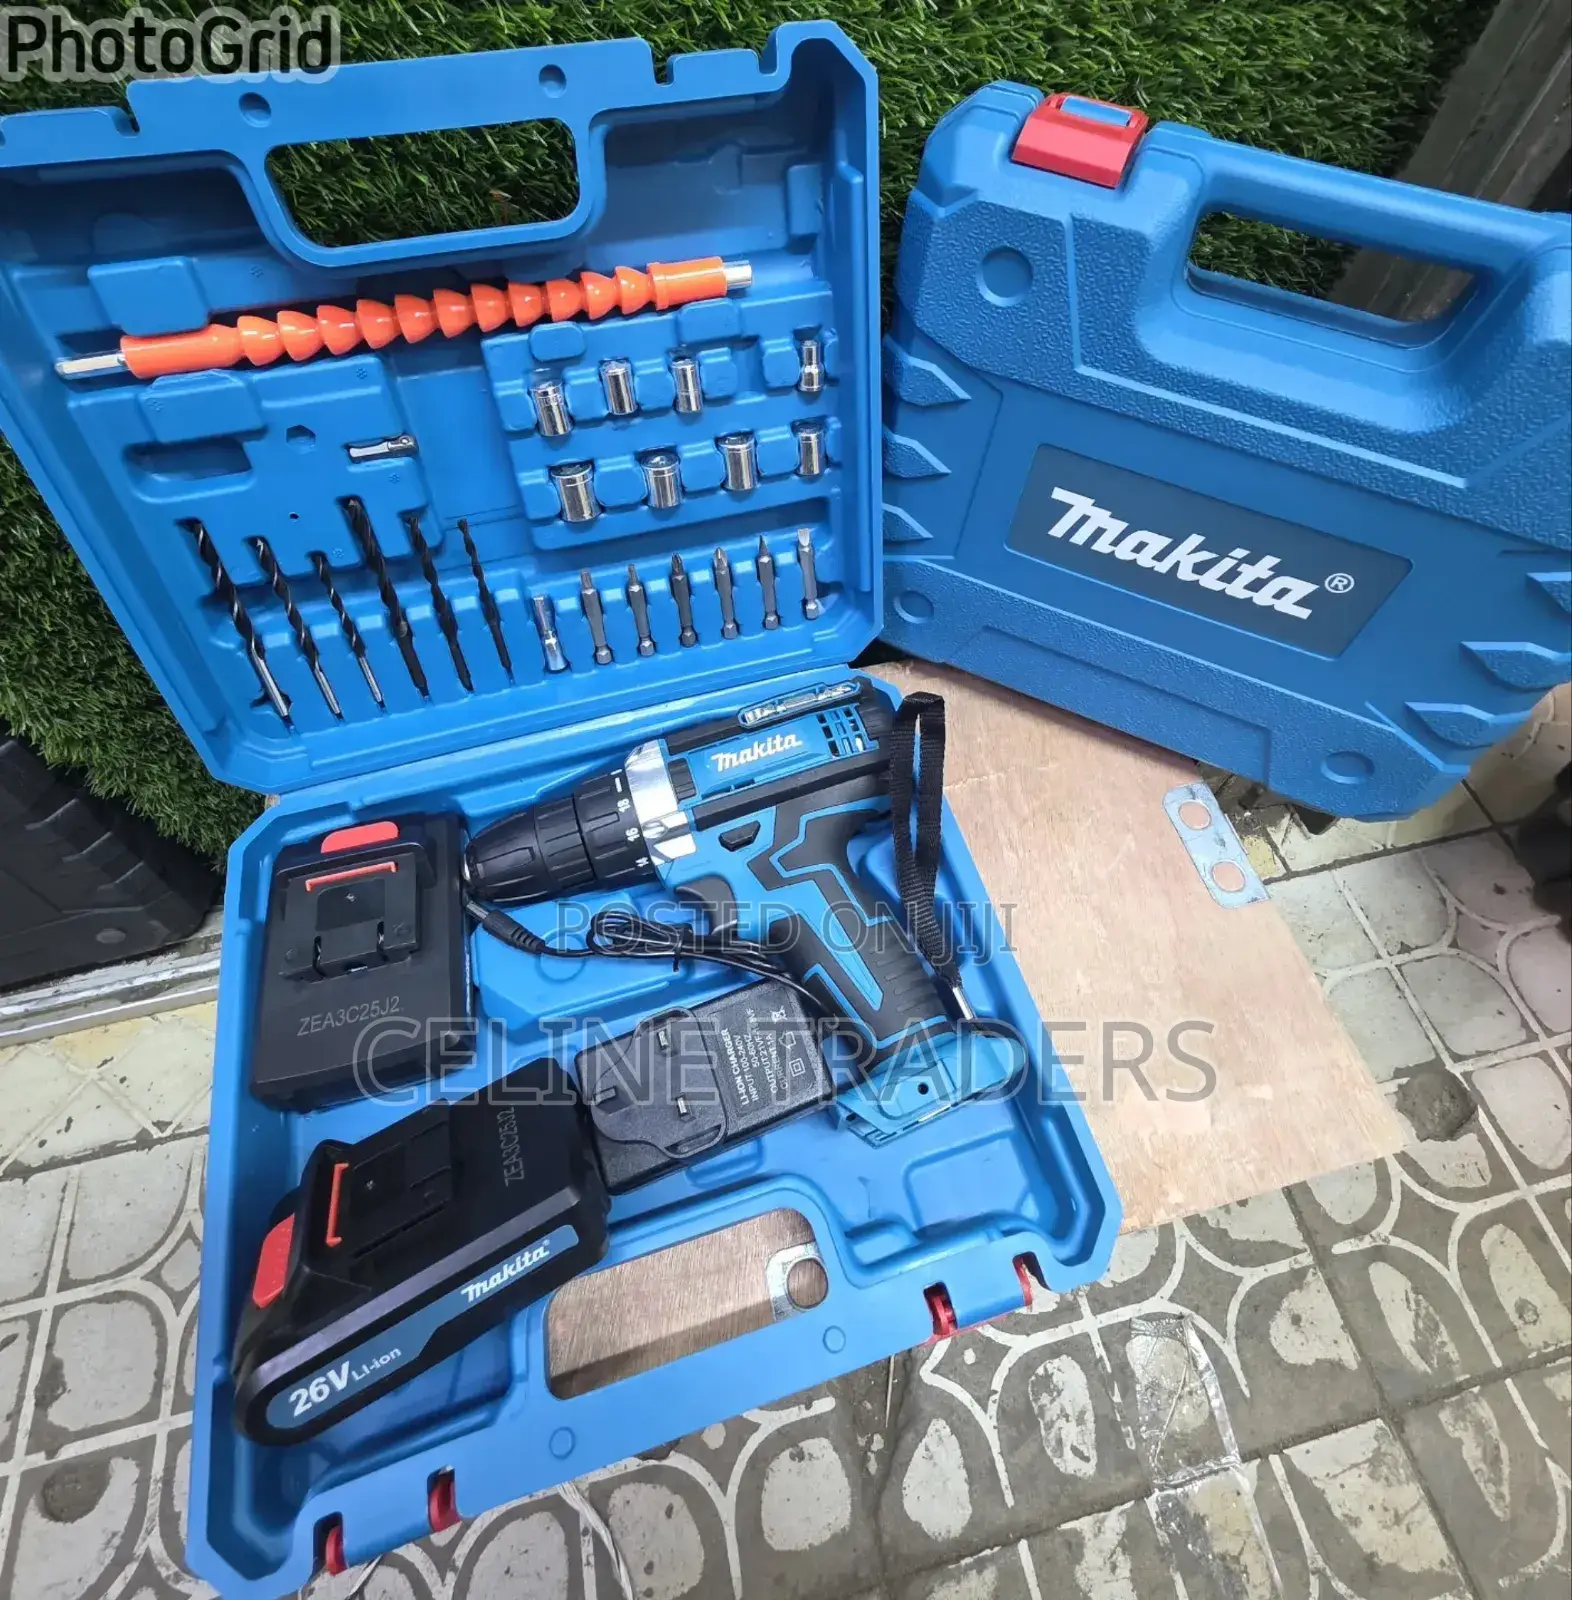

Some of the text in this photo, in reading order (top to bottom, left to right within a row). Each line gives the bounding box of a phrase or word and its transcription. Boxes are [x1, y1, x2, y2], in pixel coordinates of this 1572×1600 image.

[617, 798, 631, 813] 18
[625, 827, 640, 842] 16
[297, 995, 401, 1037] ZEA3C25J2
[720, 1028, 740, 1076] CHARGER
[733, 1034, 760, 1102] INPUT 100-240V
[288, 1361, 350, 1418] 26V
